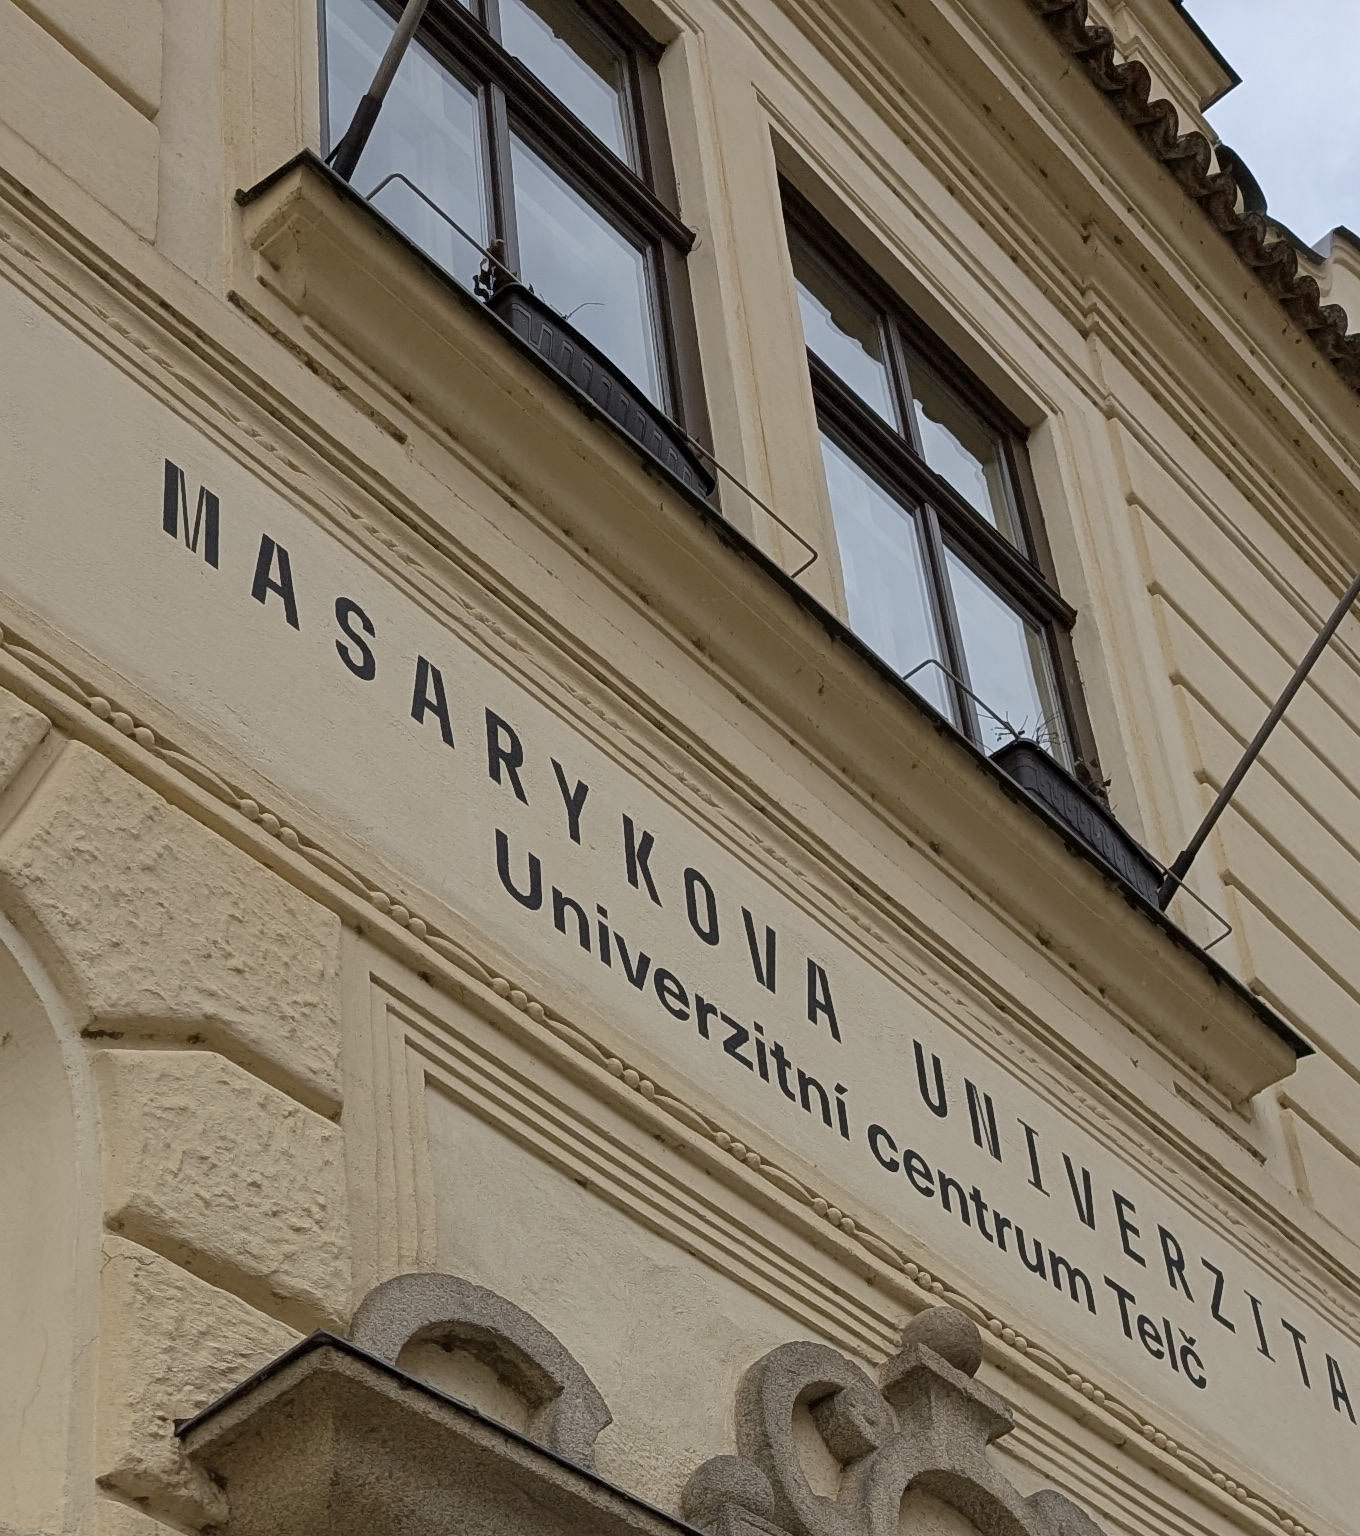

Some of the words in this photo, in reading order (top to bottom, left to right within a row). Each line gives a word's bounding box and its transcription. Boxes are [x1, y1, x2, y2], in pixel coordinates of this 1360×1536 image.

[162, 457, 842, 1044] MASARYKOVA
[912, 1038, 1358, 1425] UNIVERZITA
[494, 827, 851, 1142] Univerzitní
[867, 1123, 1098, 1317] centrum
[1103, 1273, 1208, 1390] Telč
